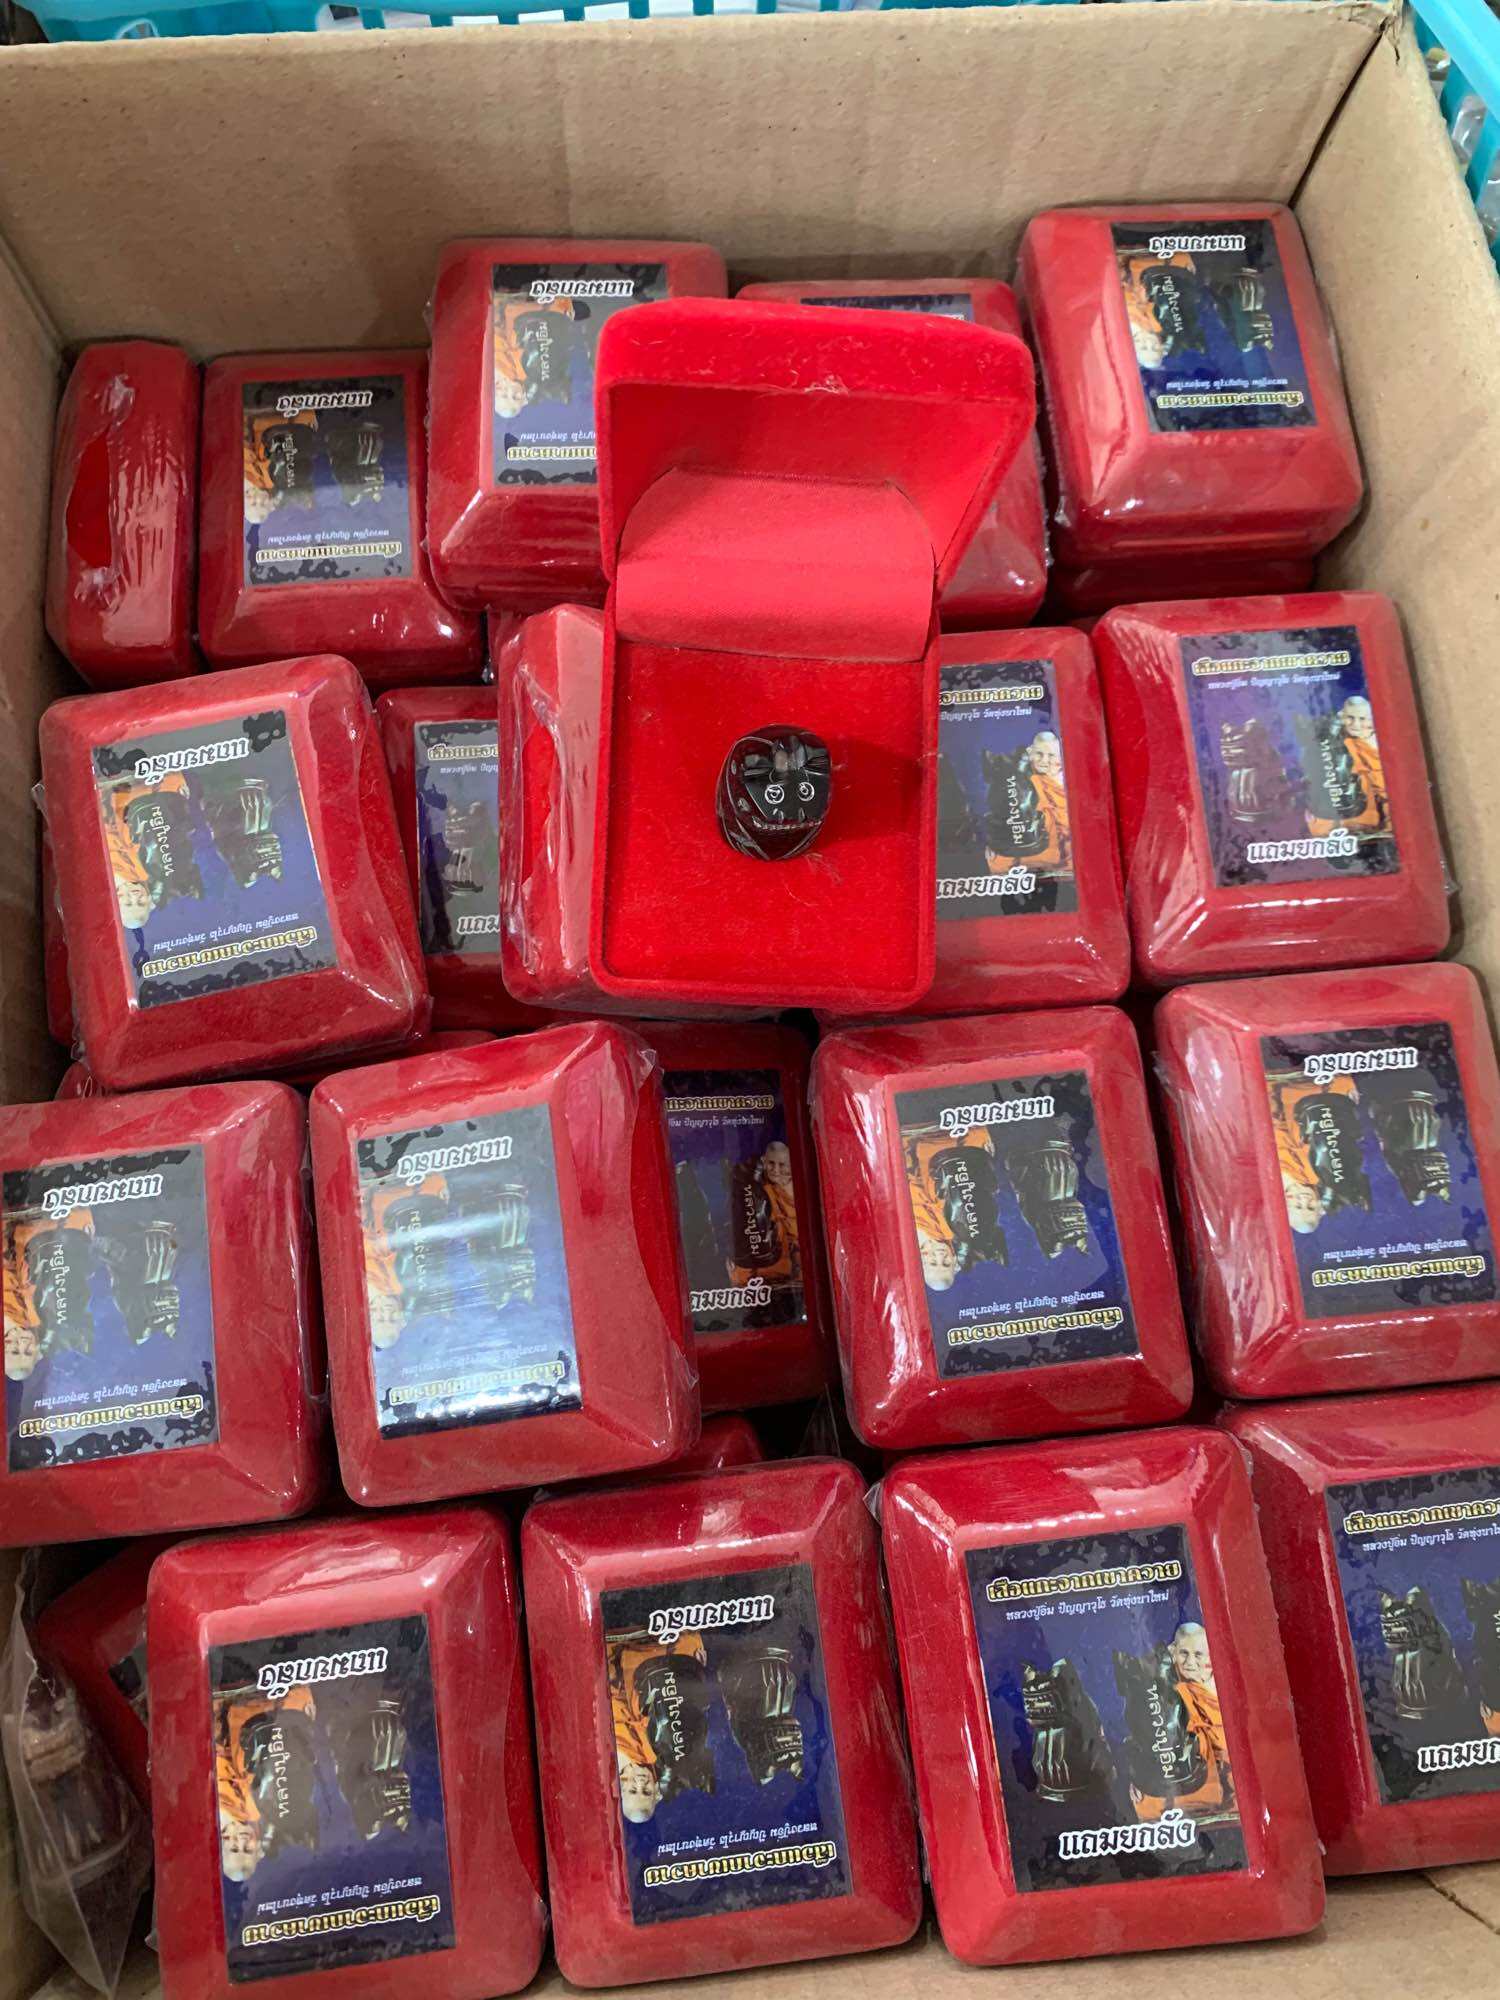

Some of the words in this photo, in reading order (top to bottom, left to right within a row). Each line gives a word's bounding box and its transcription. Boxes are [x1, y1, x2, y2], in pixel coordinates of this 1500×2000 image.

[1149, 234, 1246, 258] แถมยกลัง
[529, 279, 635, 304] แถมยกลัง
[276, 391, 373, 418] แถมยกลัง
[135, 737, 252, 785] แถมยกลัง
[1247, 828, 1358, 864] แถมยกลัง
[142, 926, 317, 978] เสือแกะจากเขาควาย
[1304, 1046, 1418, 1084] แถมยกลัง
[940, 1096, 1055, 1138] แถมยกลัง
[396, 1136, 512, 1186] แถมยกลัง
[42, 1174, 162, 1219] แถมยกลัง
[1312, 1255, 1485, 1287] เสือแกะจากเขาควาย
[948, 1307, 1124, 1346] เสือแกะจากเขาควาย
[19, 1395, 203, 1438] เสือแกะจากเขาควาย
[1344, 1498, 1500, 1535] เสือแกะจากเขาคว
[987, 1560, 1182, 1602] เสือแกะจากเขาควาย
[648, 1595, 774, 1644] แถมยกลัง
[257, 1646, 388, 1698] แถมยกลัง
[1058, 1808, 1196, 1860] แถมยกลัง
[644, 1842, 836, 1888] เสือแกะจากเขาควาย
[242, 1894, 440, 1946] เสือแกะจากเขาควาย
